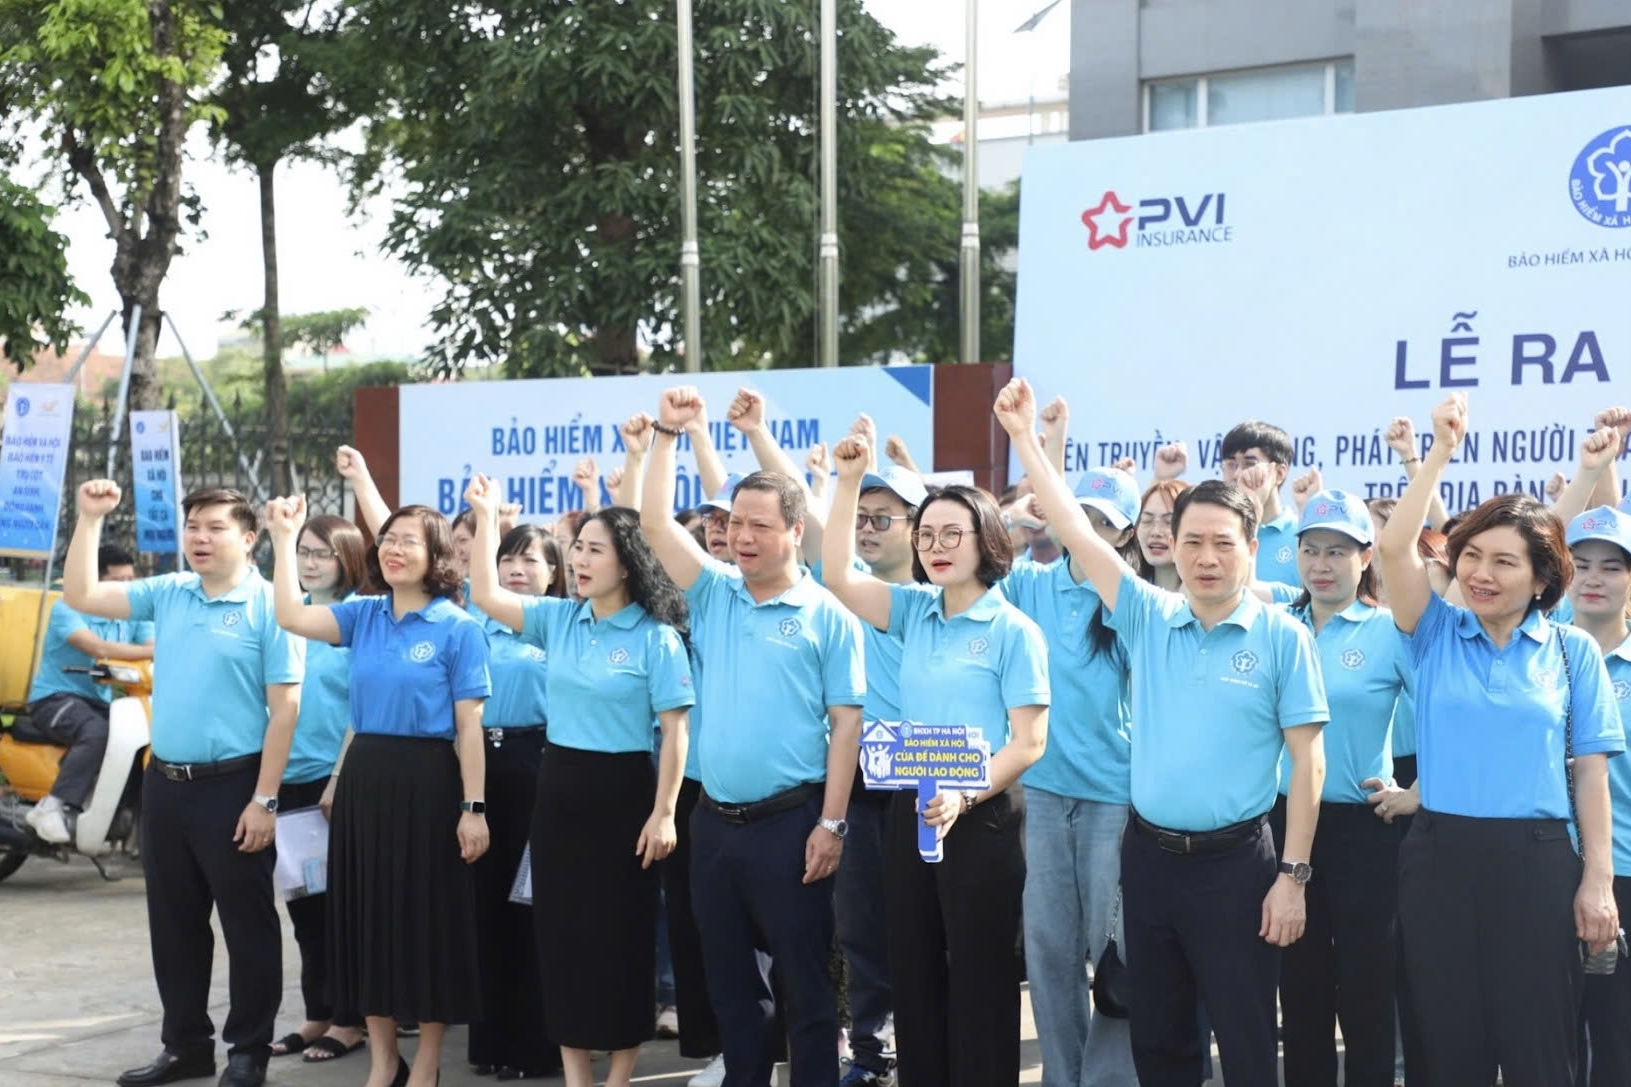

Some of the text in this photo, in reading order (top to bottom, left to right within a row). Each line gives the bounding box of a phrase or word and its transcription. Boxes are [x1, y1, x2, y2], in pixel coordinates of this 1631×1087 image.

[1138, 193, 1225, 231] PVI
[1136, 226, 1233, 248] INSURANCE
[1508, 251, 1541, 268] BẢO
[1545, 248, 1584, 266] HIỂM
[1395, 310, 1611, 390] LỄ RA
[492, 416, 536, 456] BẢO
[545, 412, 603, 454] HIỂM
[612, 424, 626, 453] X
[1098, 428, 1180, 471] TRUYỀ
[1198, 433, 1224, 475] VẬ
[1492, 422, 1575, 463] NGƯỜI
[508, 459, 583, 515] HIỂM
[1329, 504, 1348, 514] PV
[1597, 519, 1619, 529] PV
[895, 749, 914, 761] CỦA
[929, 750, 957, 763] DÀNH
[958, 752, 980, 763] CHO
[894, 764, 979, 779] NGƯỜI LAO ĐỘNG
